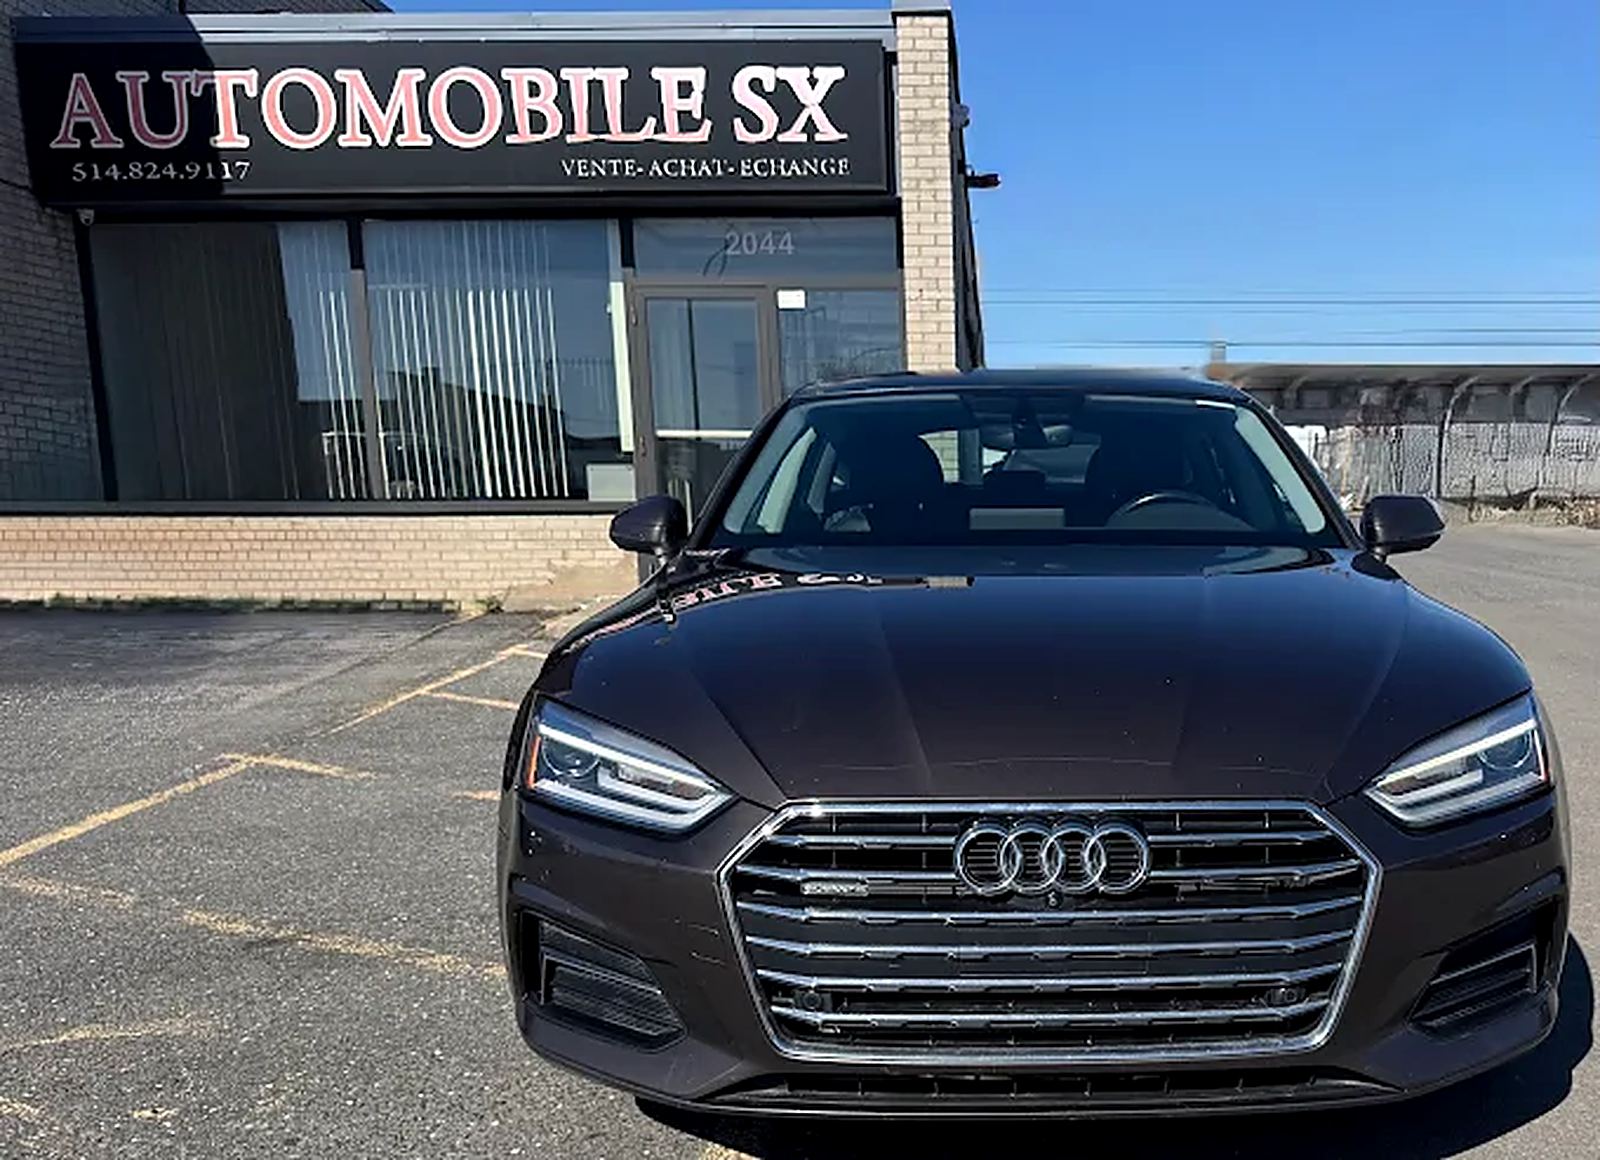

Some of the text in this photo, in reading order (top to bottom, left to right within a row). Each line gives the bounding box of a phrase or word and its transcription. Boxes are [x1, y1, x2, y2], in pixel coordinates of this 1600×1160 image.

[50, 65, 848, 150] AUTOMOBILE SX
[72, 161, 251, 182] 514.824.9117
[740, 158, 850, 177] ECHANGE
[725, 231, 795, 255] 2044
